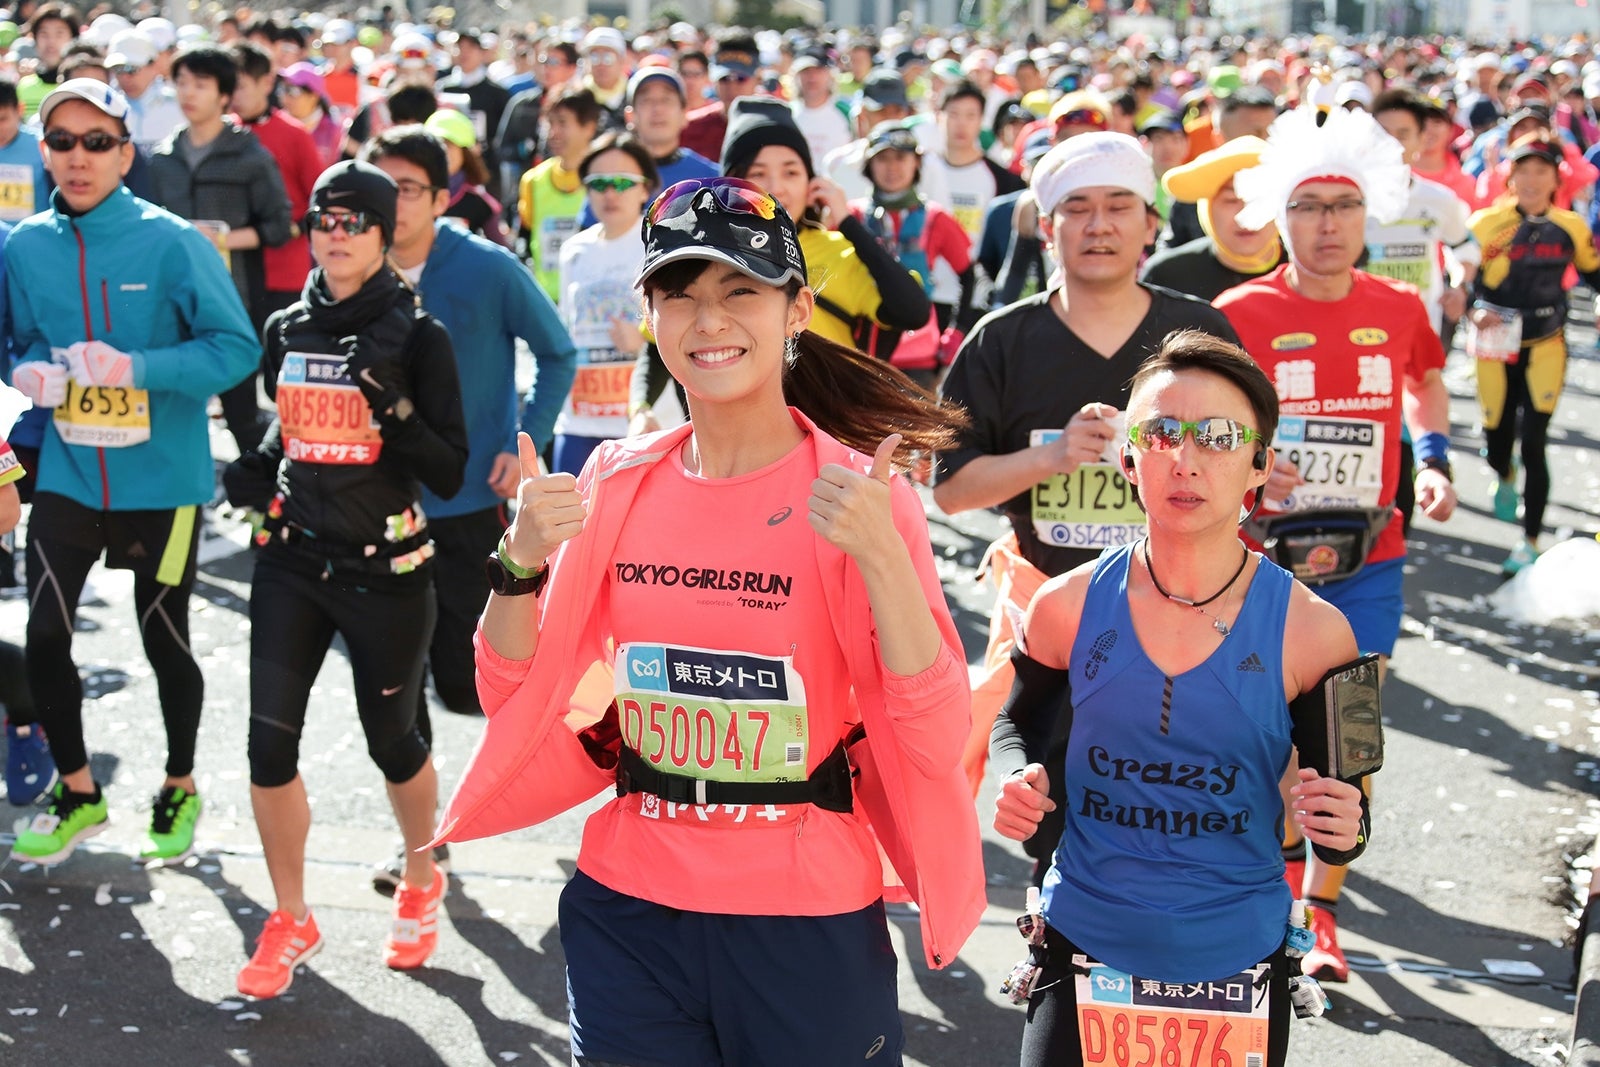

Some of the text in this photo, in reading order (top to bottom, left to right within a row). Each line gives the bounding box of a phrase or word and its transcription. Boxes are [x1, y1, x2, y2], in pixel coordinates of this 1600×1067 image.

[1307, 423, 1372, 442] 東京メトロ
[1273, 448, 1363, 486] 92367
[1036, 469, 1136, 510] E3129
[615, 563, 793, 597] TOKYO GIRLS RUN
[673, 661, 778, 689] 東京メトロ
[1236, 664, 1266, 673] adidas
[622, 699, 770, 771] D50047
[1088, 745, 1241, 796] Crazy
[1077, 785, 1250, 837] Runner
[1139, 979, 1244, 1002] 東京メトロ
[1082, 1008, 1233, 1067] D85876
